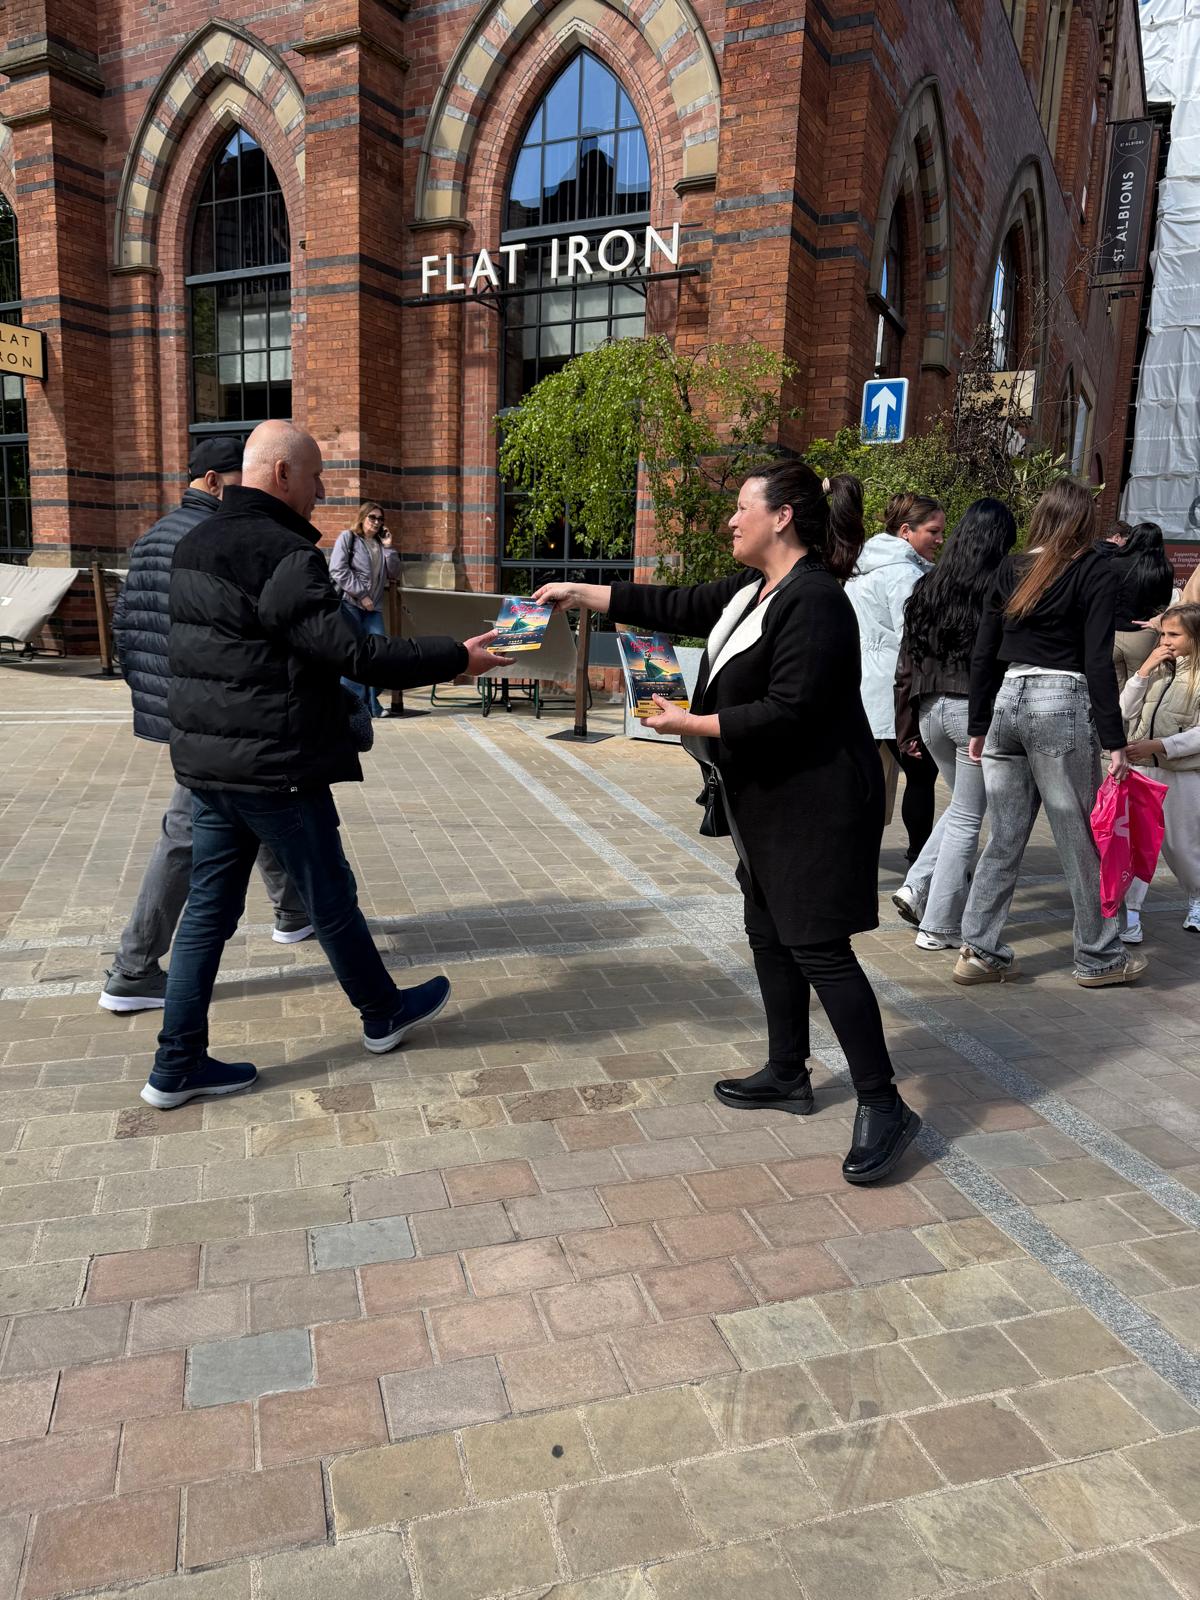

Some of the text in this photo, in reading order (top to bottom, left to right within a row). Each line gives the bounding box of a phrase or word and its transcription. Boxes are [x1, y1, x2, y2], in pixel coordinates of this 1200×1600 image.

[1115, 171, 1135, 242] ALBIONS
[421, 222, 681, 294] FLAT IRON
[0, 329, 30, 347] LAT
